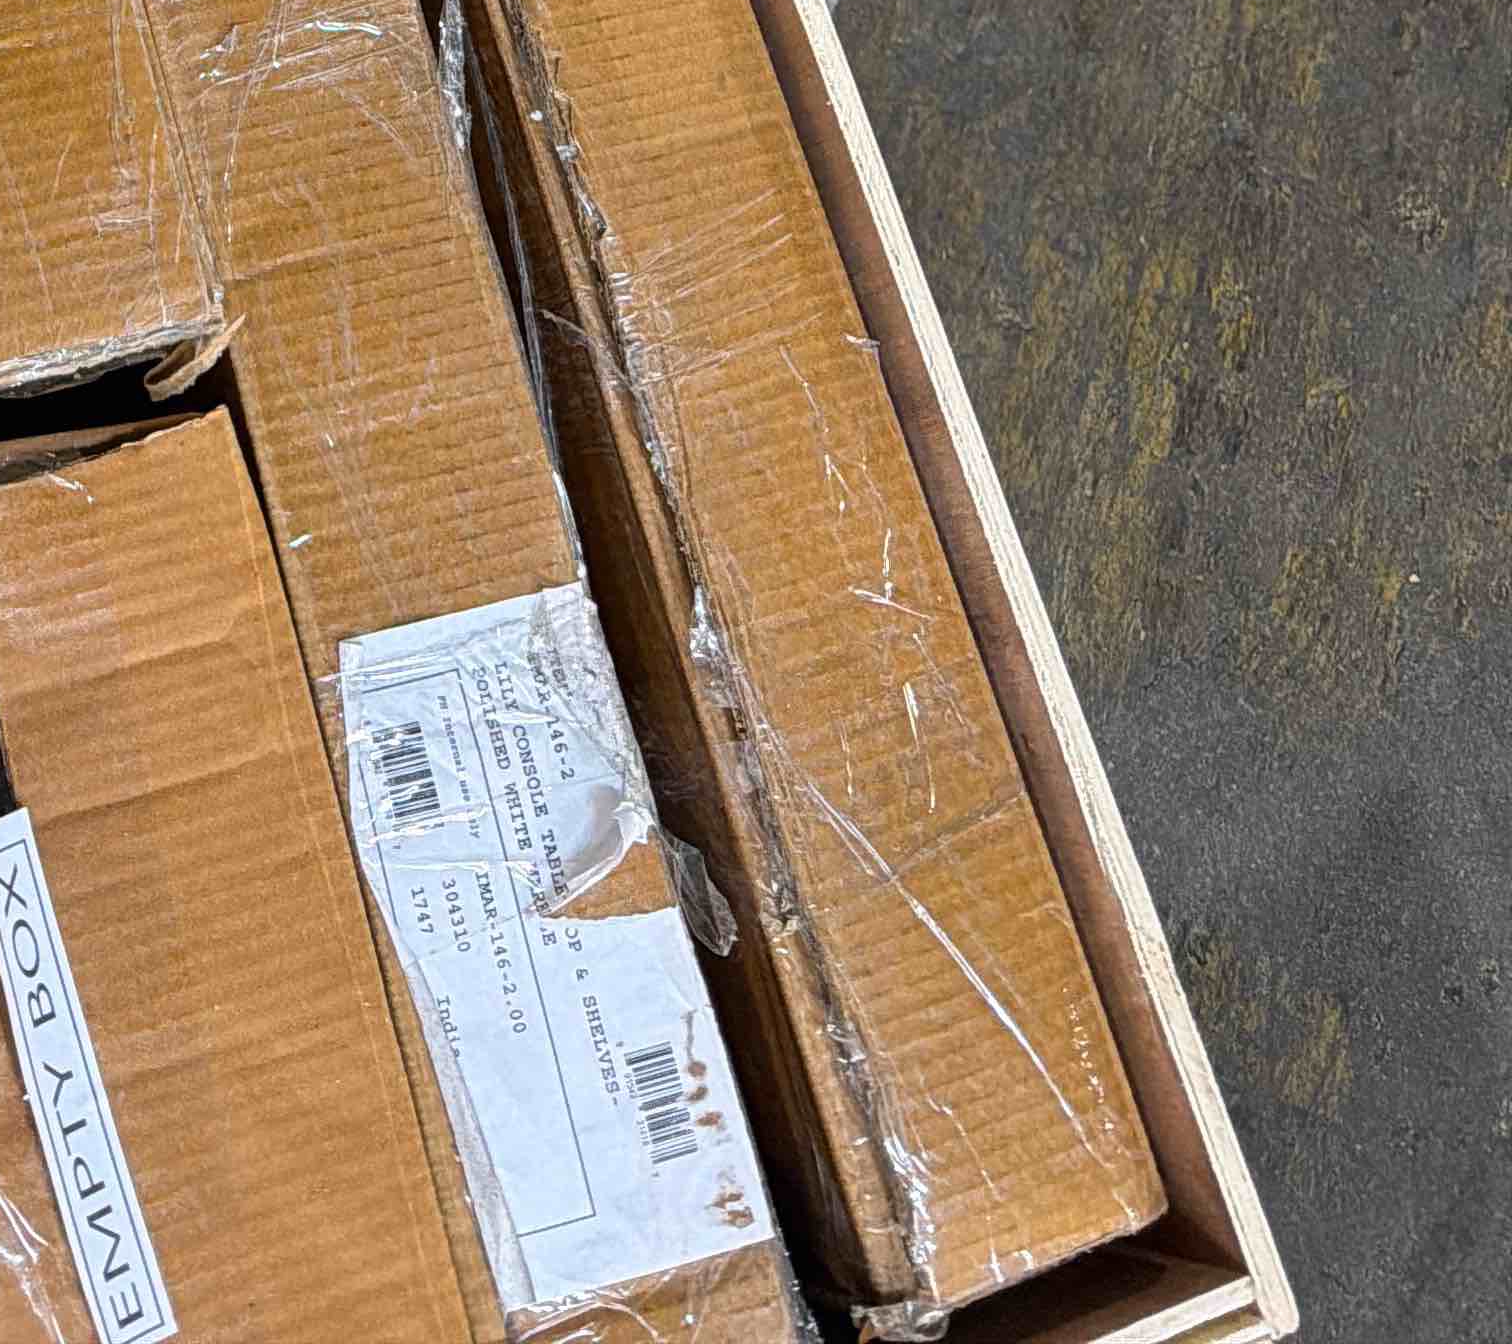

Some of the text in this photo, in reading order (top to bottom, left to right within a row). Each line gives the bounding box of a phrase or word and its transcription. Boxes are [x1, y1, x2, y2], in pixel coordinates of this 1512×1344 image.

[468, 664, 514, 773] POLISHED
[499, 780, 533, 853] WHITE
[490, 658, 523, 716] LILY
[508, 720, 551, 819] CONSOLE
[572, 965, 591, 984] &
[406, 884, 436, 938] 1747
[438, 876, 474, 955] 304310
[470, 868, 529, 1037] IMAR-146-2.00
[432, 992, 466, 1061] India
[42, 1062, 144, 1329] EMPTY
